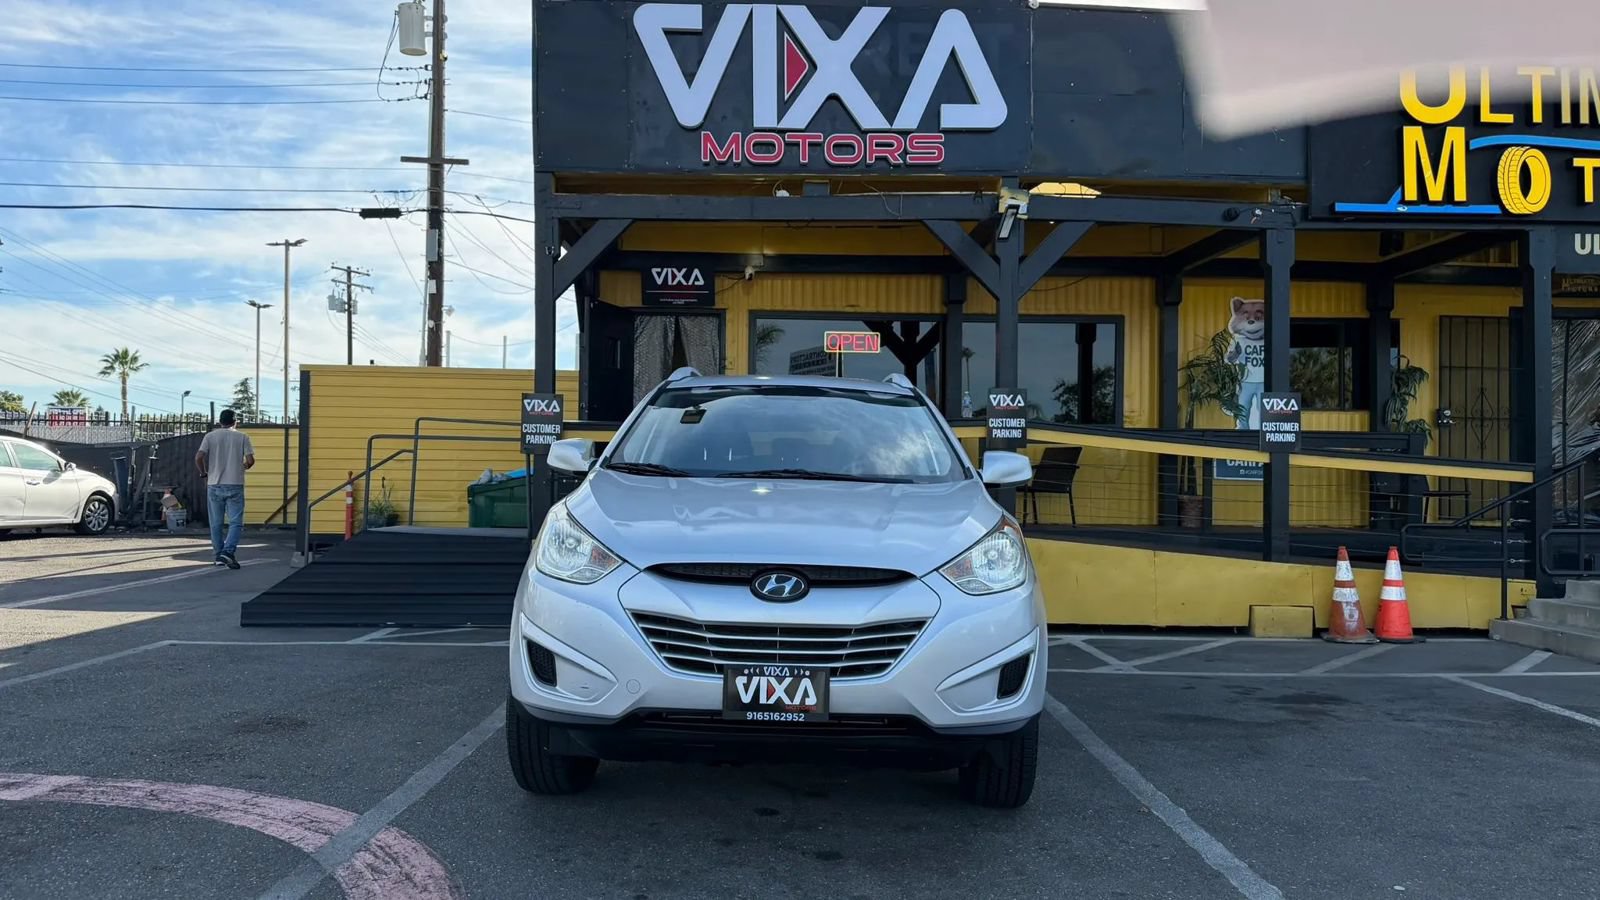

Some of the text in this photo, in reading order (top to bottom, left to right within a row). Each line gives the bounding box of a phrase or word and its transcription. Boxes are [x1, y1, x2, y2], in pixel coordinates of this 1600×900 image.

[633, 3, 1008, 130] VIXA
[701, 131, 945, 166] MOTORS
[651, 267, 704, 285] VIXA
[827, 334, 878, 350] OPEN
[1244, 357, 1264, 367] FOX
[523, 399, 560, 412] VIXA
[989, 394, 1024, 406] VIXA
[1262, 398, 1298, 410] VIXA
[989, 418, 1025, 427] CUSTOMER
[1262, 422, 1299, 431] CUSTOMER
[522, 423, 560, 434] CUSTOMER
[992, 429, 1022, 438] PARKING
[525, 435, 557, 445] PARKING
[1265, 432, 1296, 442] PARKING
[763, 667, 790, 676] VIXA
[735, 676, 817, 705] VIXA
[746, 711, 805, 722] 9165162952
